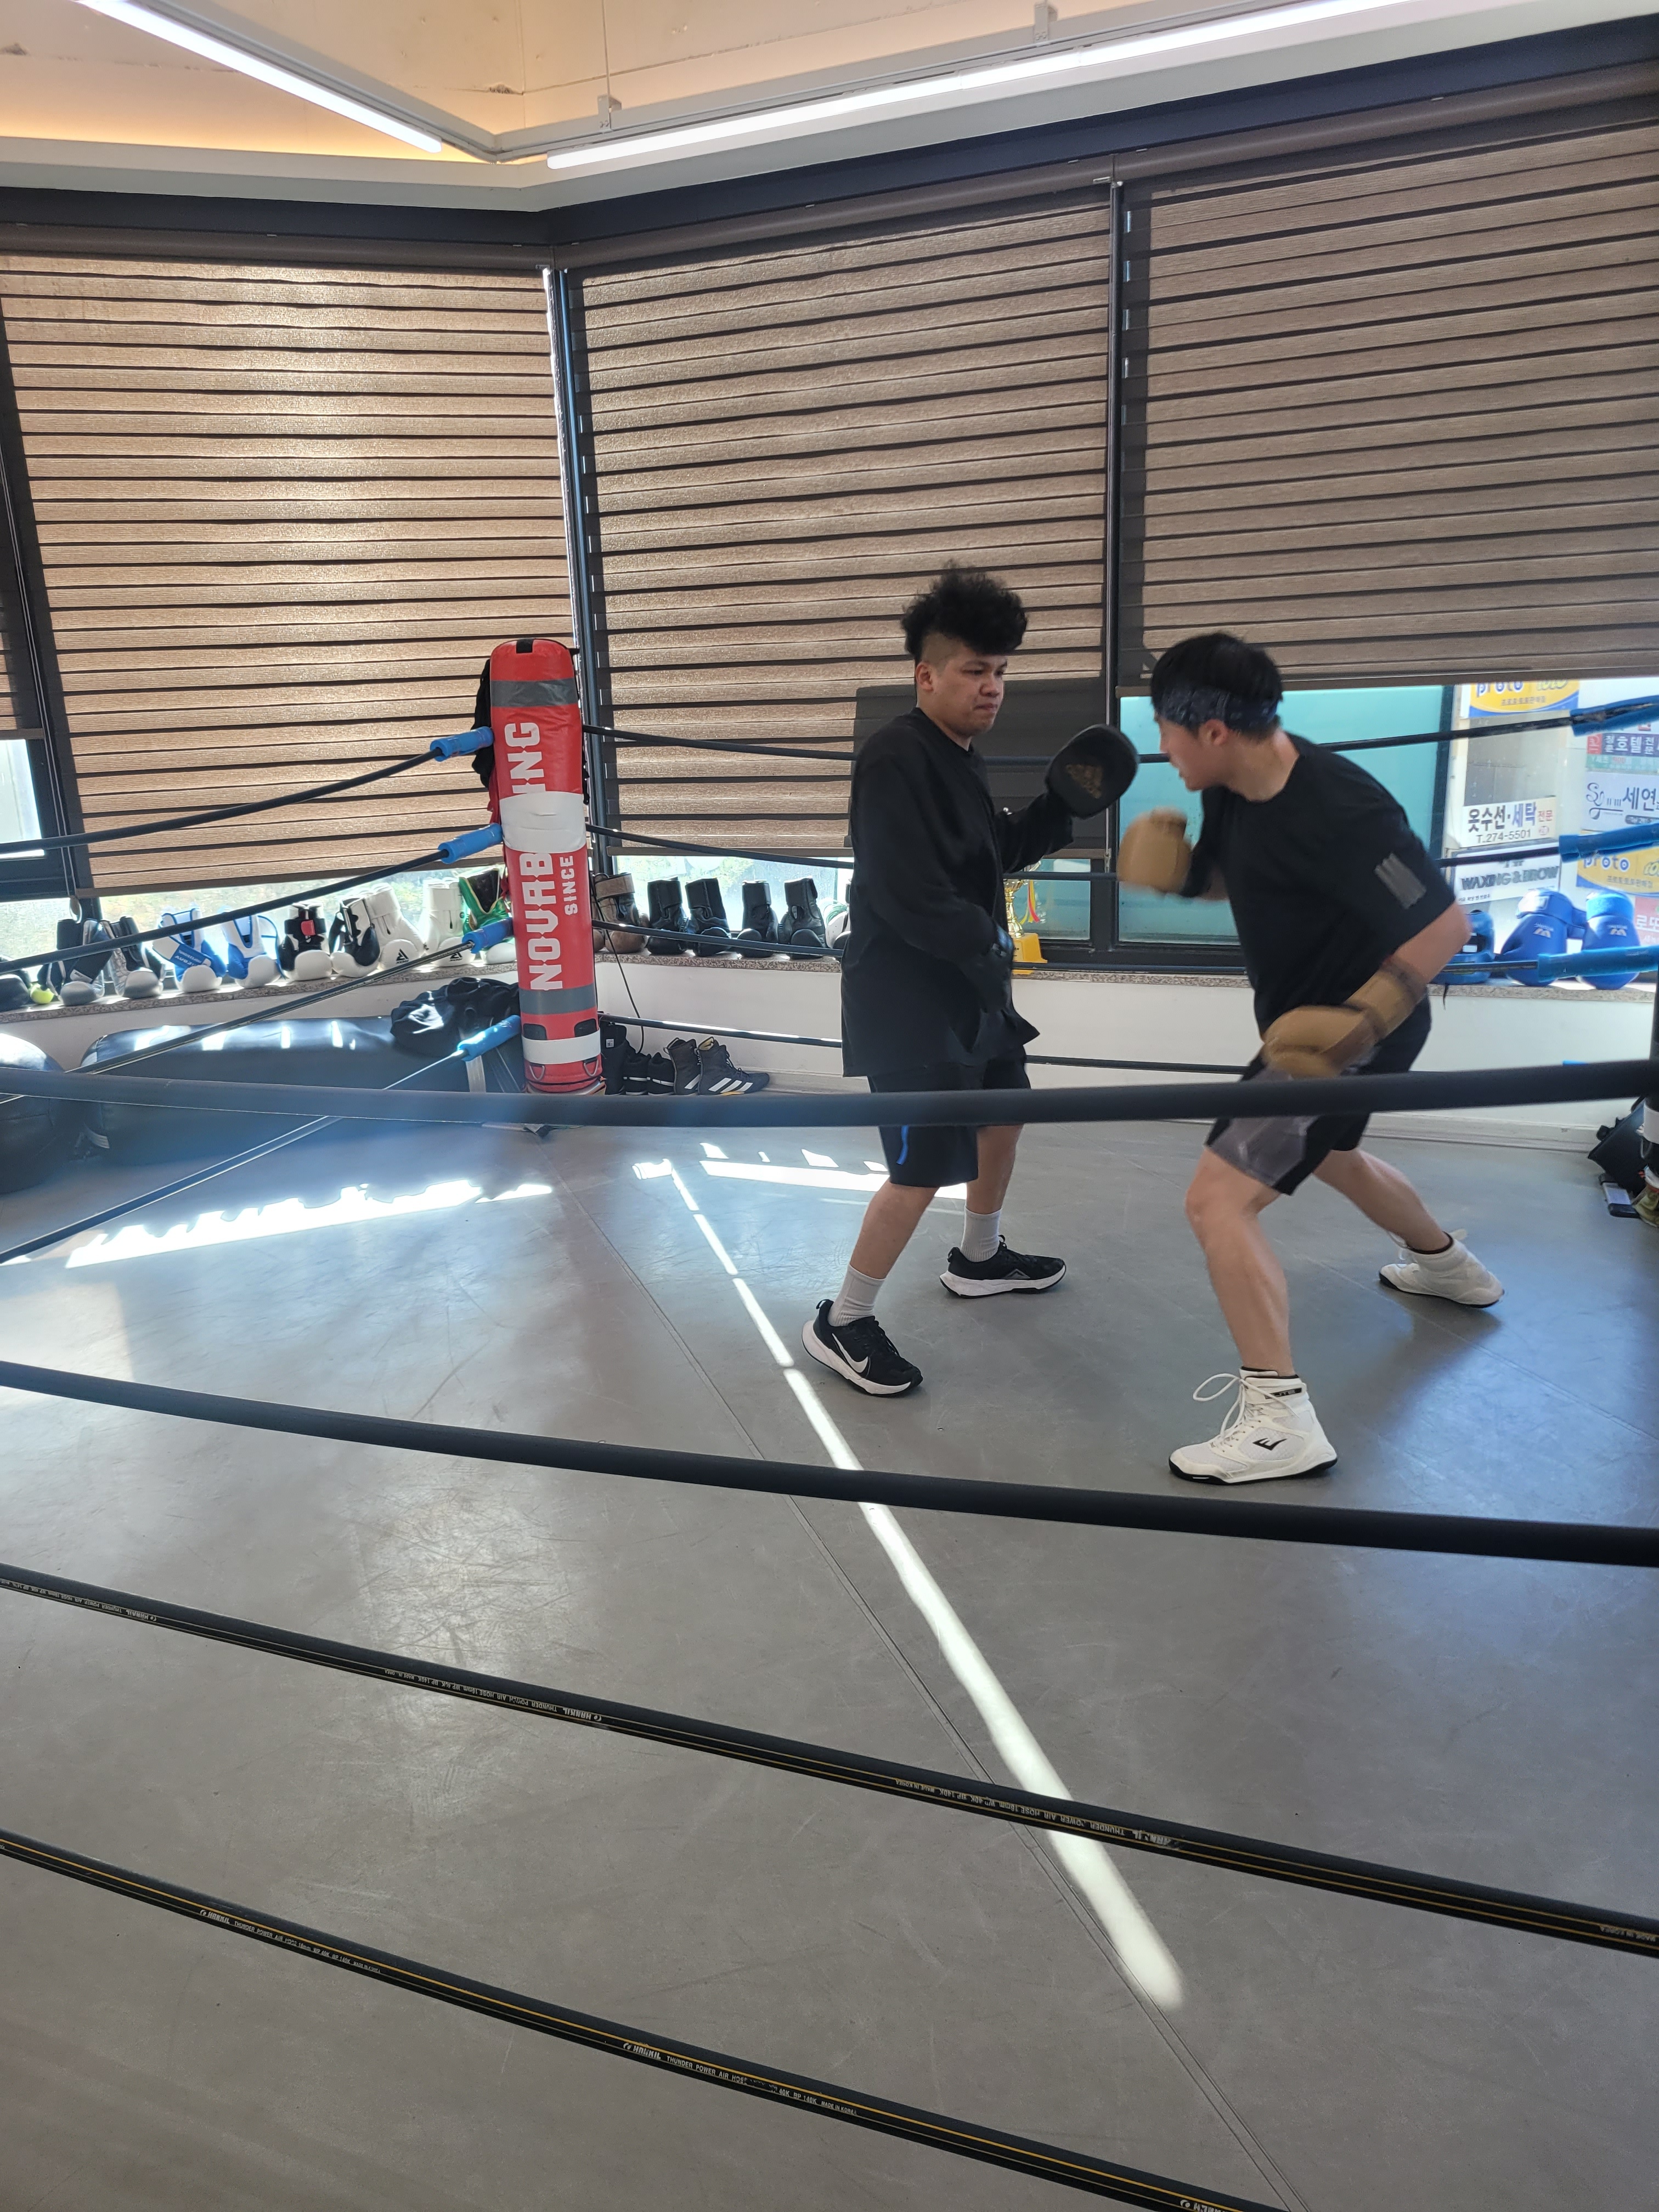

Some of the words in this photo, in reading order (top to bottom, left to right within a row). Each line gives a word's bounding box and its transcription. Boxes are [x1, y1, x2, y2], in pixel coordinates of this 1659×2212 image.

[1477, 830, 1531, 844] T.274-5501
[560, 855, 578, 916] SINCE
[532, 1701, 557, 1711] THUNDER
[1090, 1822, 1125, 1835] THUNDER
[234, 1921, 254, 1932] THUNDER
[257, 1928, 272, 1937] POWER
[666, 2056, 692, 2068] THUNDER
[696, 2064, 715, 2075] POWER
[803, 2095, 817, 2104] 140K
